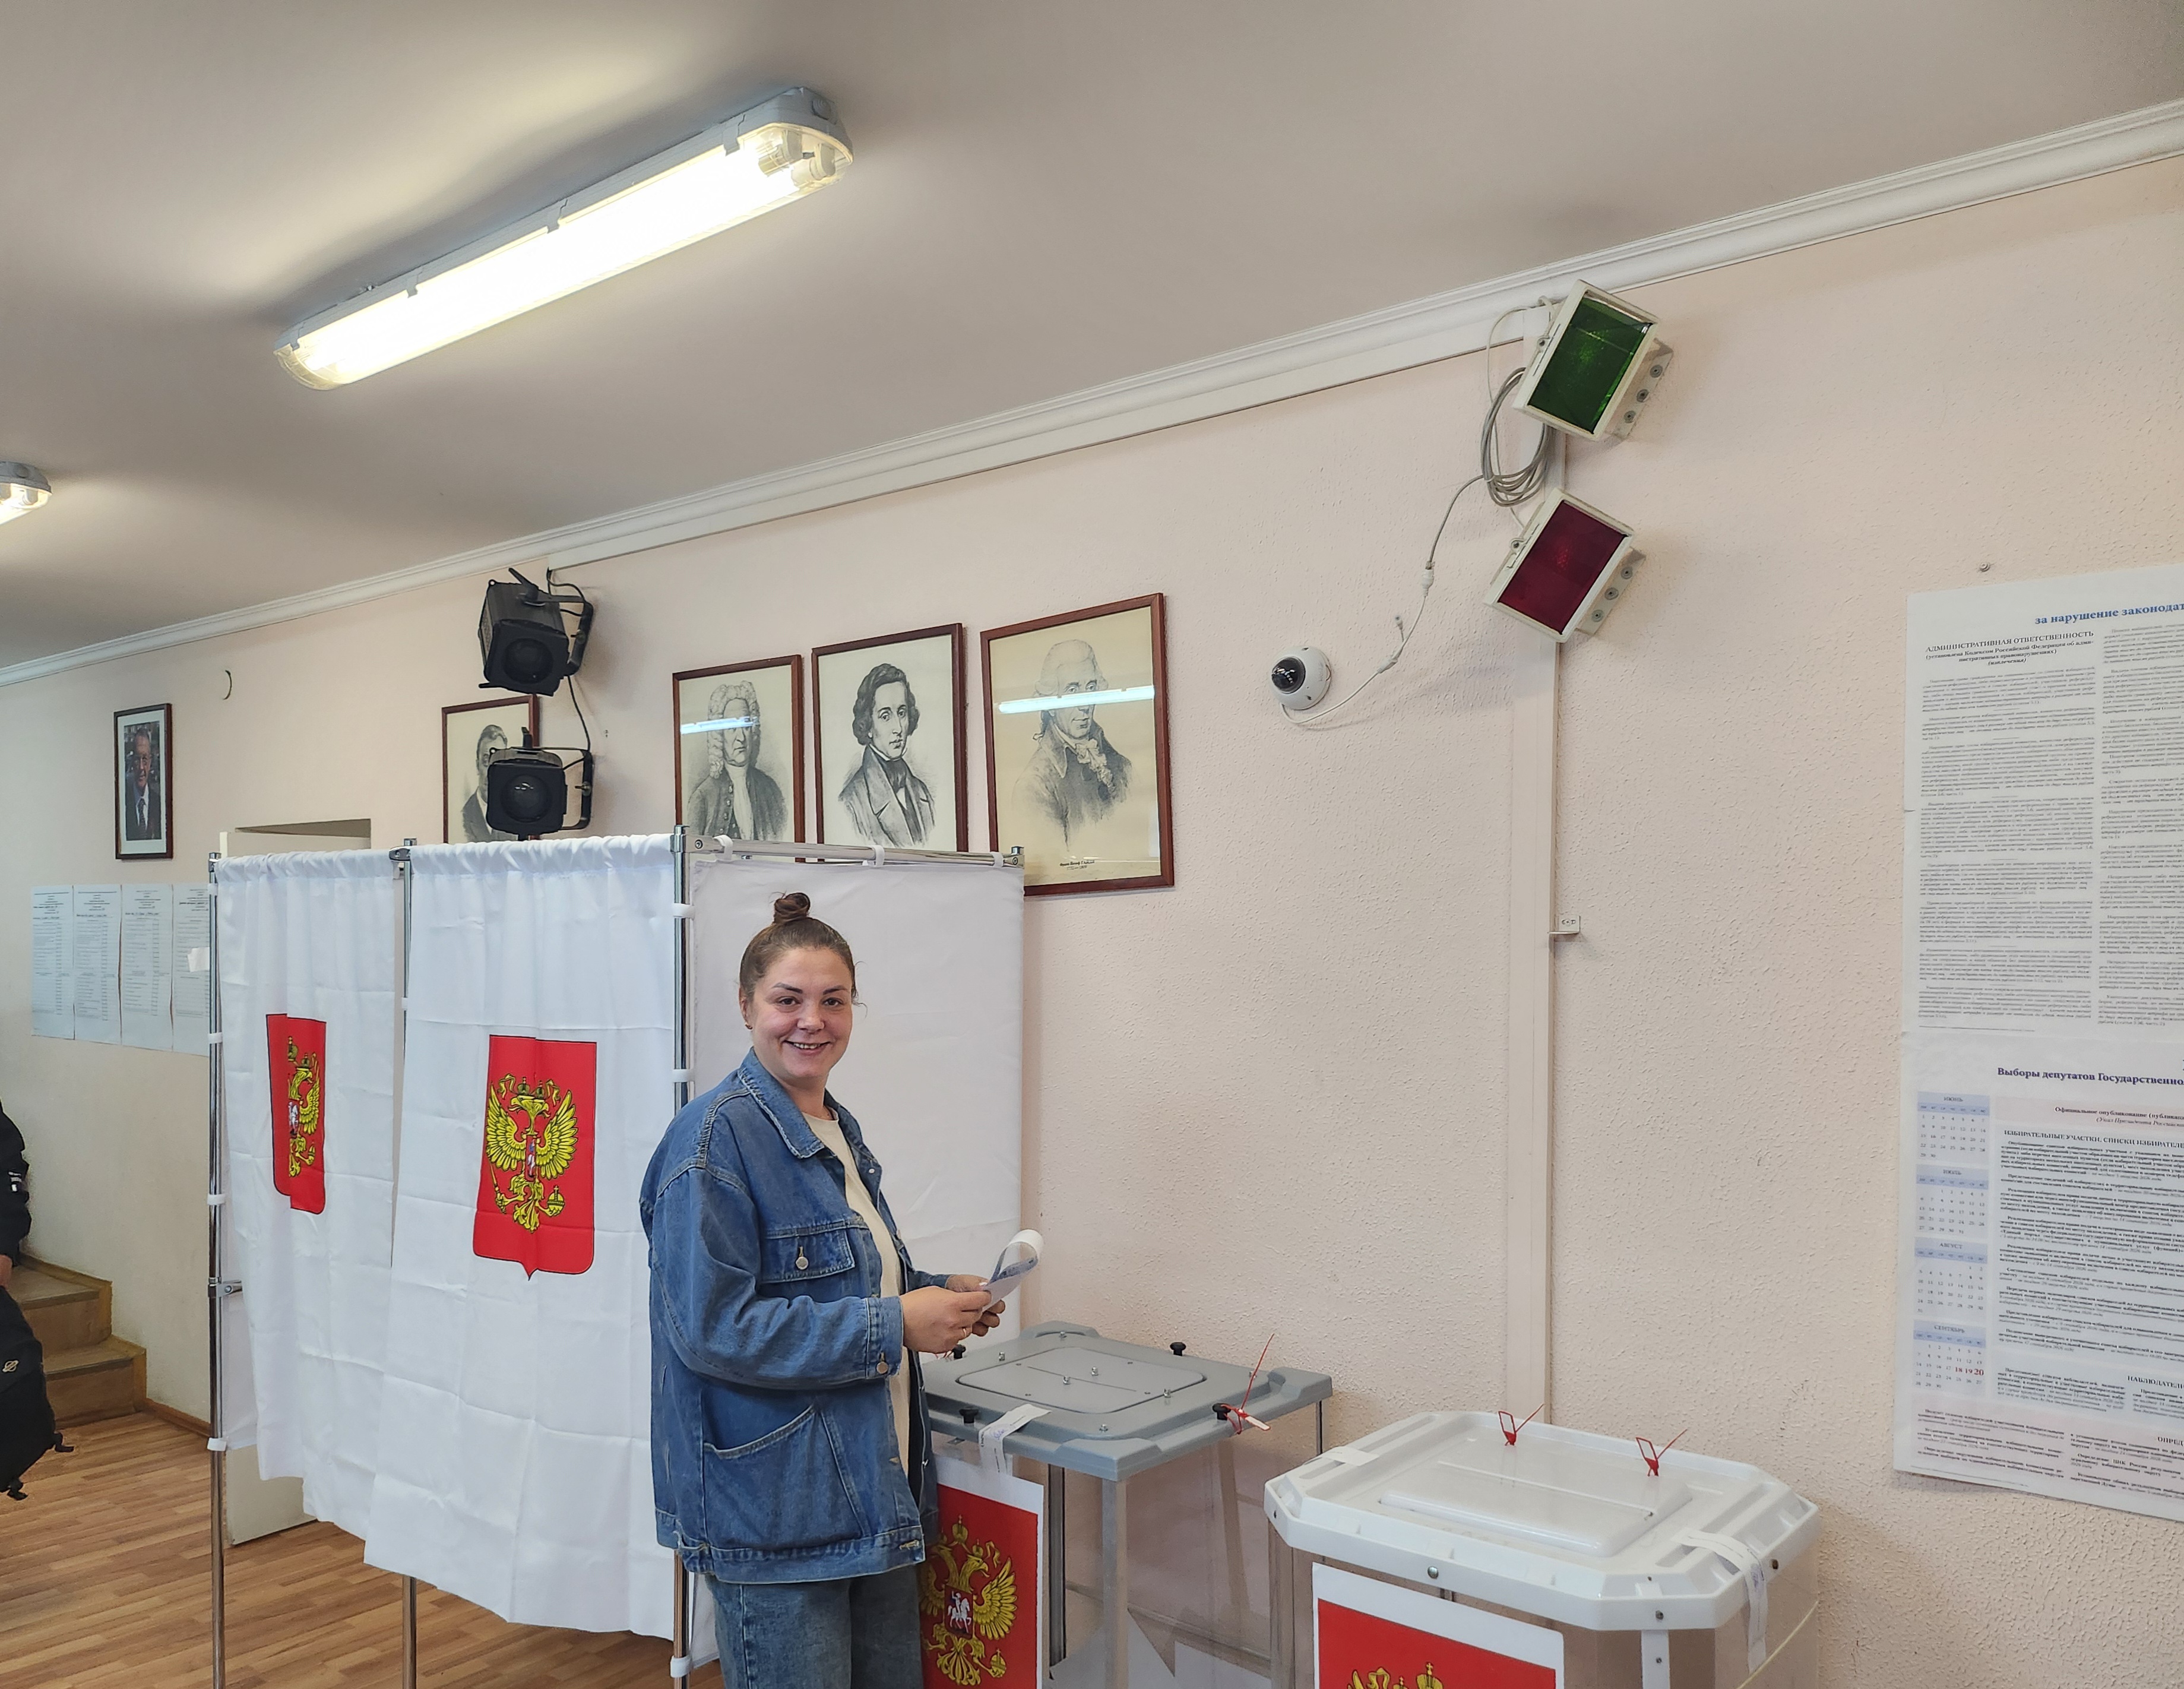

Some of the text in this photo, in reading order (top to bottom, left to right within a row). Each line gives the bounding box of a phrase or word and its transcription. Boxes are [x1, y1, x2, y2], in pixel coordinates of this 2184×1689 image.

[2035, 616, 2047, 624] за
[2050, 610, 2119, 624] нарушение
[1925, 631, 2094, 652] АДМИНИСТРАТИВНАЯ ОТВЕТСТВЕННОСТЬ
[1998, 1067, 2040, 1079] Выборы
[2042, 1071, 2095, 1081] депутатов
